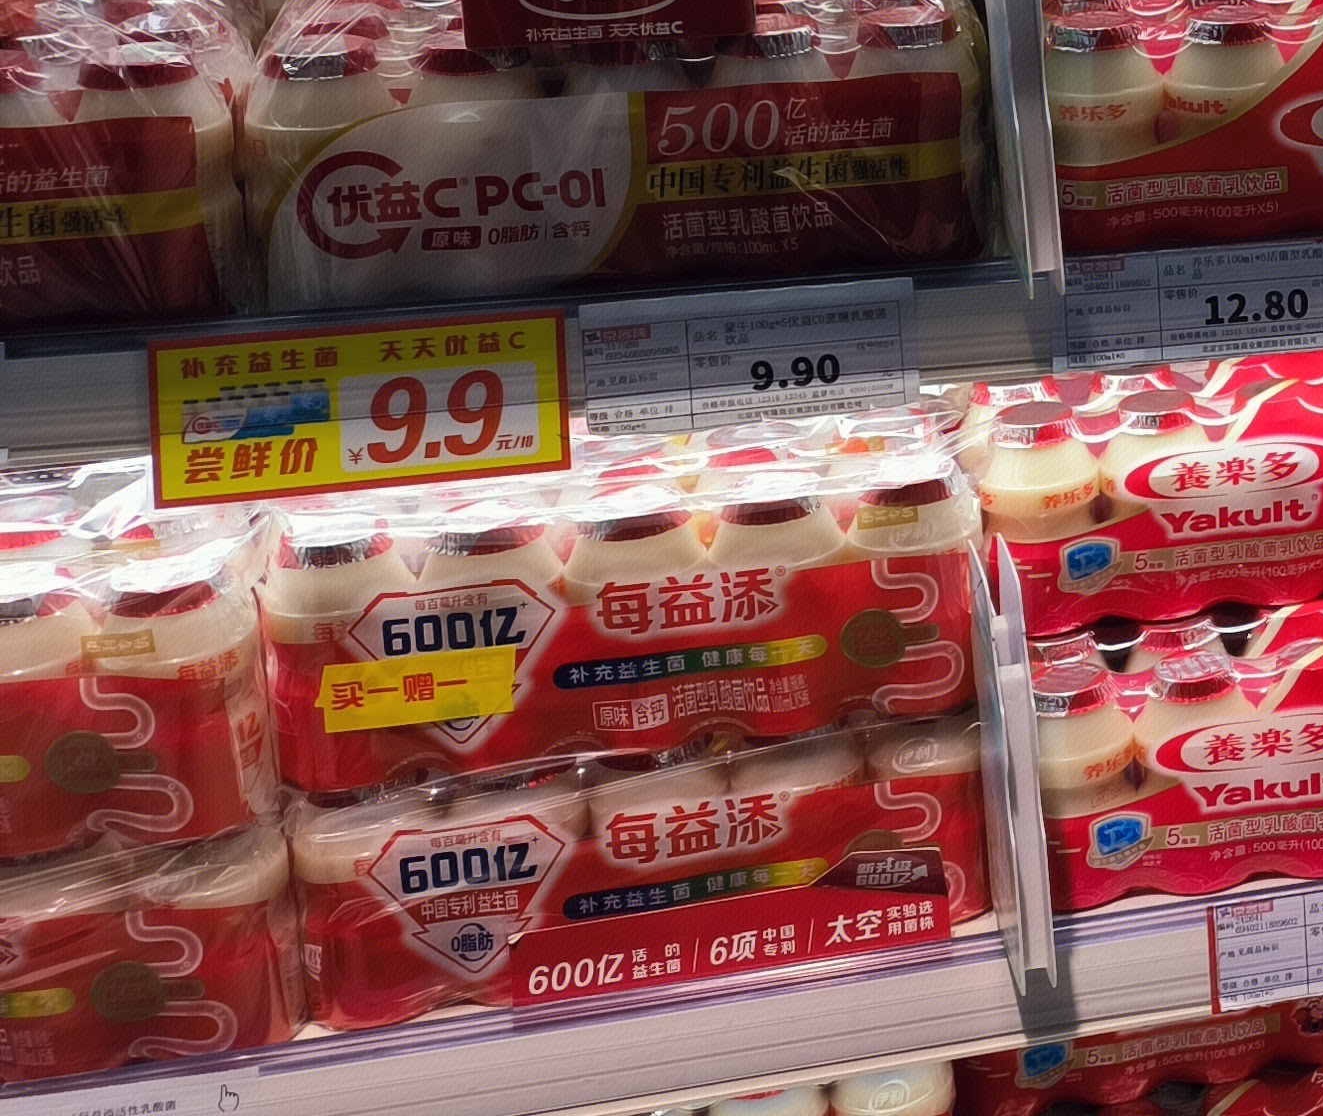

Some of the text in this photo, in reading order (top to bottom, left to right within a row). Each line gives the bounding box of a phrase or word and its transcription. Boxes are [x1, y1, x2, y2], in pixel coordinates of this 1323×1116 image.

[525, 18, 684, 43] 补充益生菌 天天优益C
[659, 100, 780, 157] 500
[785, 114, 892, 145] 活的益生菌
[1057, 102, 1129, 122] 养乐多
[648, 154, 909, 200] 中国专利益生菌 强活性
[1106, 171, 1281, 206] 活菌型乳酸菌乳饮品
[488, 218, 592, 246] 0脂肪 含钙
[662, 198, 834, 239] 活菌型乳酸菌饮品
[431, 229, 473, 248] 原味
[1164, 288, 1198, 300] 零售价
[1205, 288, 1309, 325] 12.80
[180, 330, 527, 379] 补充益生菌 天天优益C
[694, 355, 732, 367] 零售价
[750, 353, 841, 390] 9.90
[366, 368, 505, 465] 9.9
[183, 438, 320, 483] 尝鲜价
[1160, 498, 1312, 533] Yakult
[595, 570, 779, 633] 每益添
[381, 605, 527, 660] 600亿
[569, 637, 816, 684] 补充益生菌 健康每一天
[330, 672, 470, 708] 买一赠一
[598, 704, 630, 729] 原味
[634, 700, 666, 726] 含钙
[605, 793, 784, 865] 每益添
[398, 844, 541, 894] 600亿
[420, 891, 520, 922] 中国专利益生菌
[578, 884, 691, 915] 补充益生菌
[887, 901, 934, 919] 实验选
[762, 924, 795, 941] 中国
[825, 909, 882, 946] 太空
[887, 916, 934, 934] 用菌株
[709, 930, 757, 965] 6项
[763, 940, 796, 956] 专利
[529, 952, 624, 994] 600亿
[632, 960, 681, 979] 益生菌
